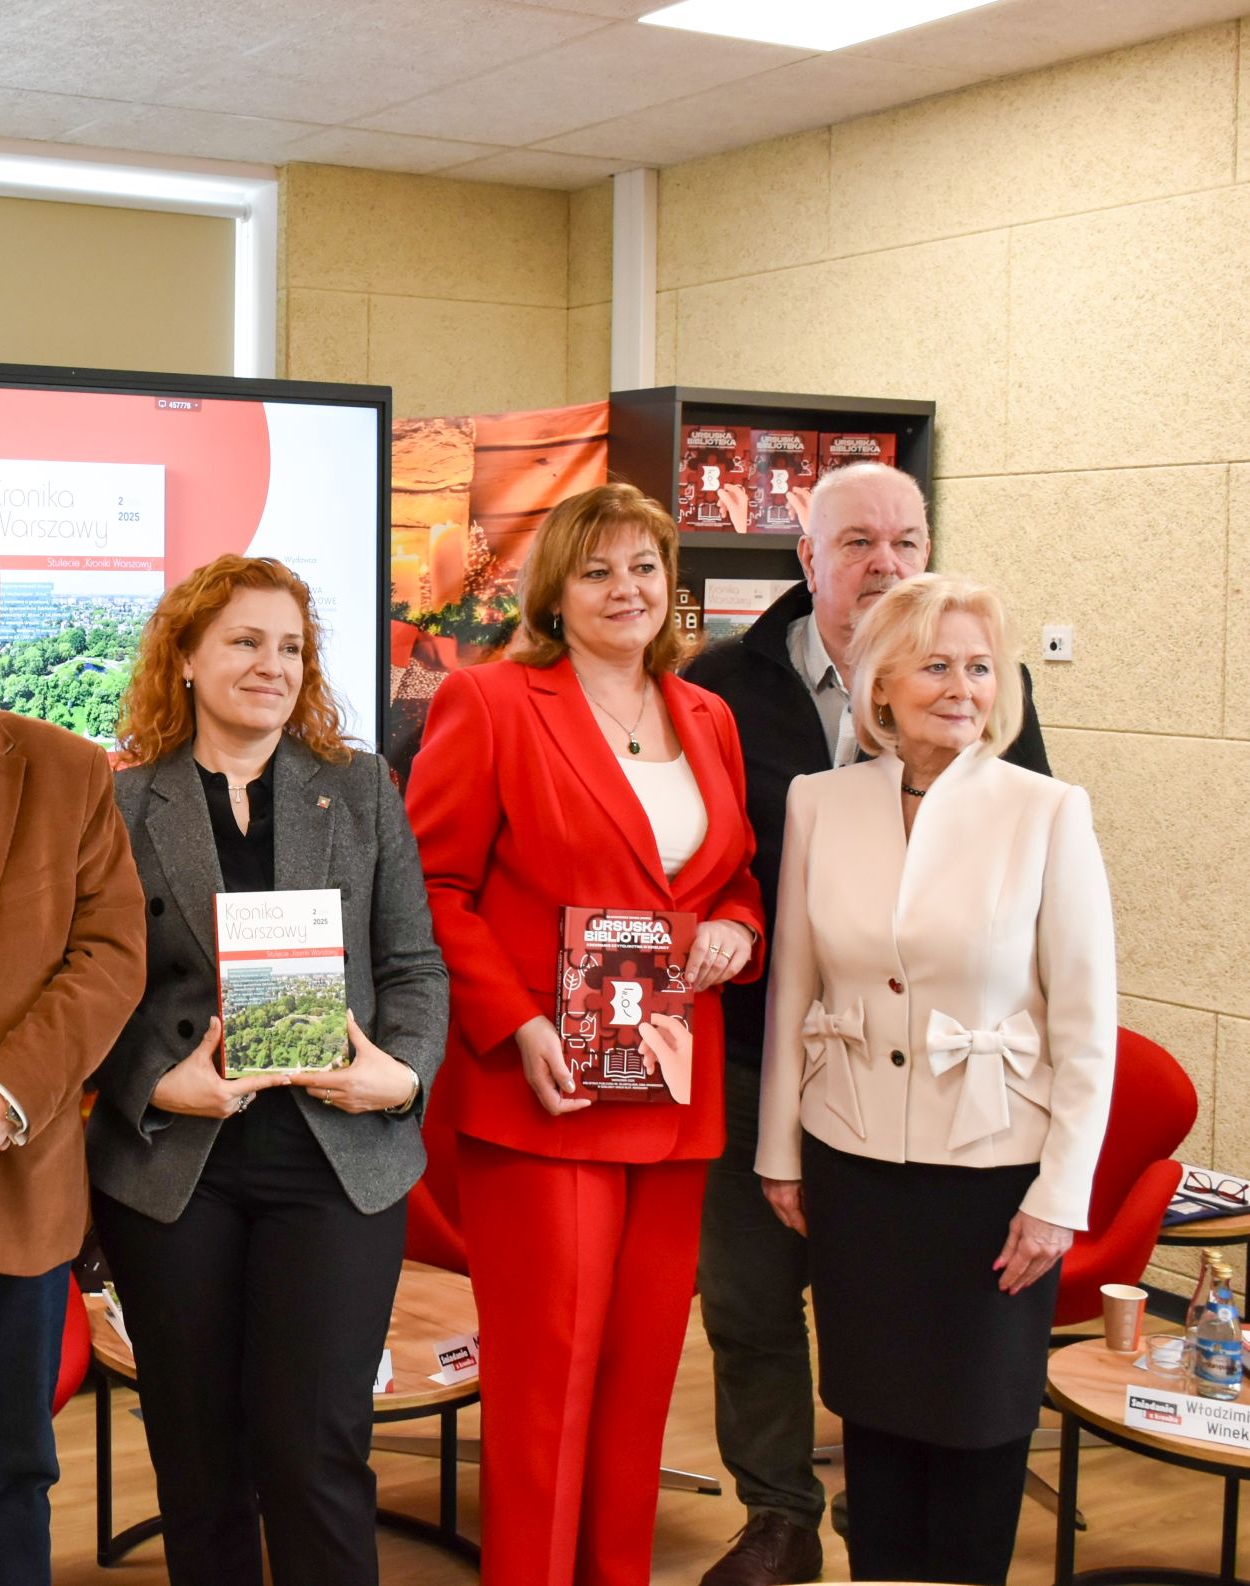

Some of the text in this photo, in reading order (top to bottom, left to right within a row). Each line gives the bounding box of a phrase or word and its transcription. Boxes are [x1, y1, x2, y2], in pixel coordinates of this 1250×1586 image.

[691, 431, 732, 440] URSUSKA
[760, 435, 800, 444] URSUSKA
[686, 437, 737, 446] BIBLIOTEKA
[756, 441, 805, 450] BIBLIOTEKA
[834, 439, 876, 447] URSUSKA
[829, 445, 881, 453] BIBLIOTEKA
[117, 496, 124, 505] 2
[117, 512, 140, 521] 2025
[47, 557, 80, 567] Stulecie
[225, 902, 284, 920] Kronika
[592, 920, 665, 933] URSUSKA
[225, 922, 307, 943] Warszawy
[584, 930, 672, 944] BIBLIOTEKA
[1207, 1421, 1250, 1441] Winek
